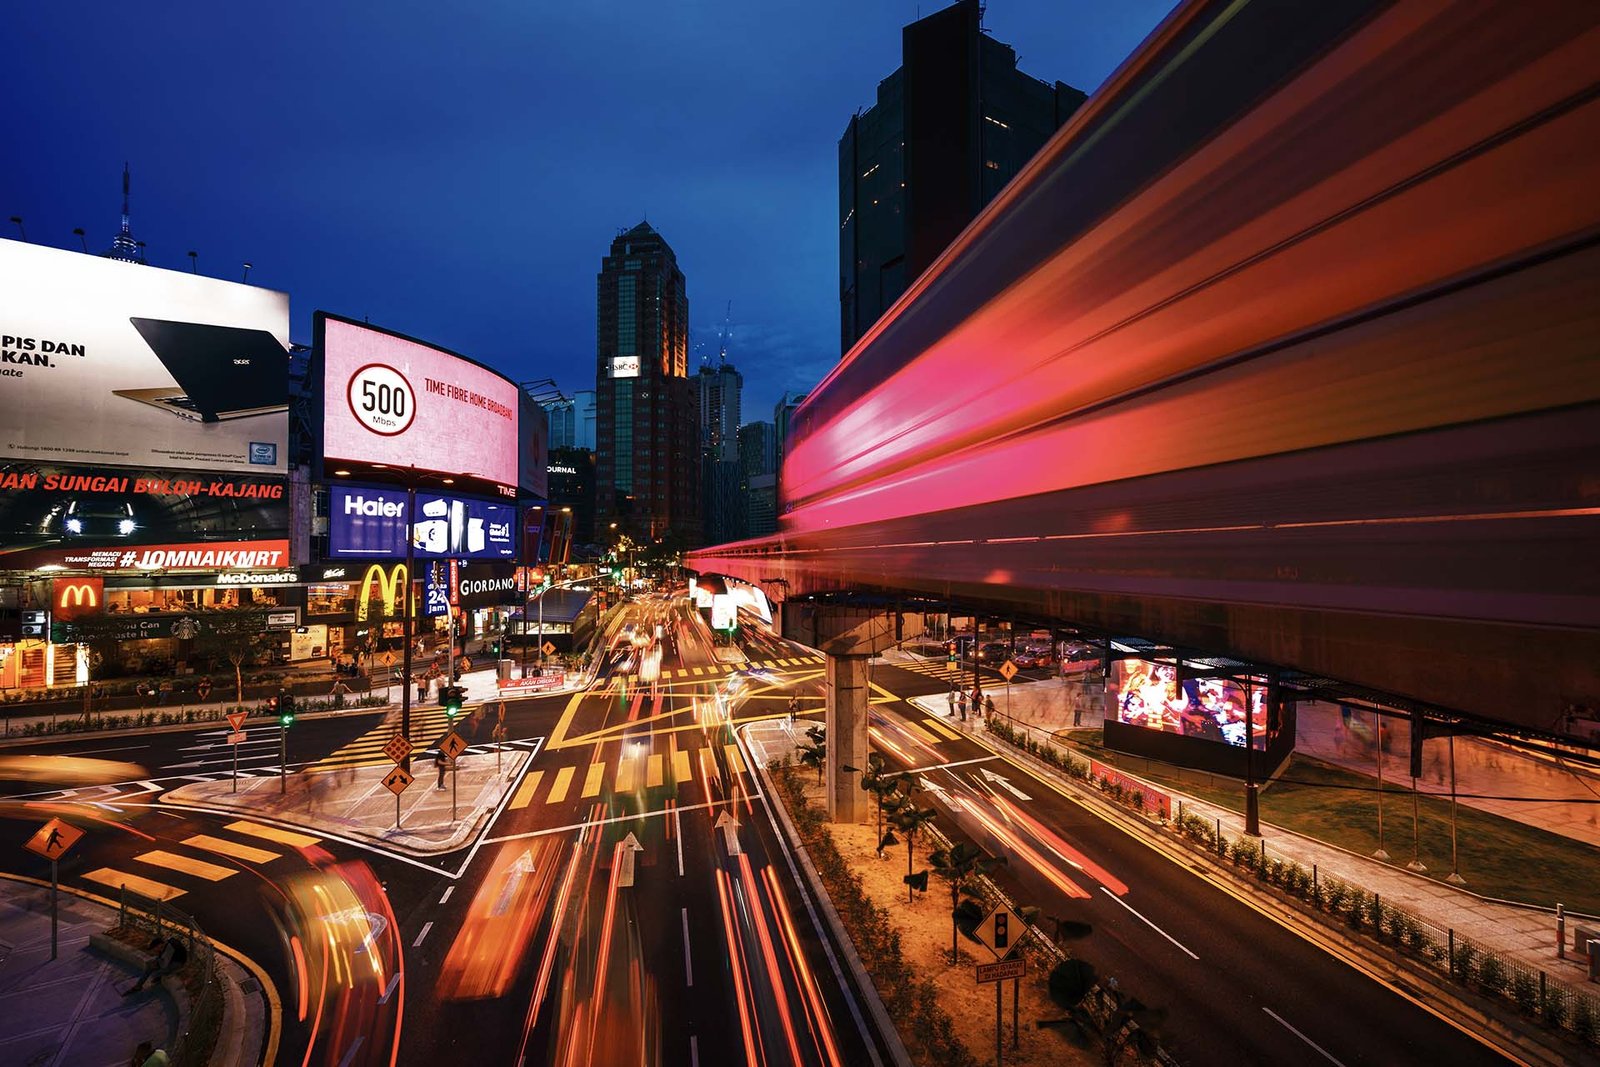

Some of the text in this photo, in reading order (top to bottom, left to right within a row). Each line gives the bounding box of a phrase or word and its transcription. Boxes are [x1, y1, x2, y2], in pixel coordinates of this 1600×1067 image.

[2, 335, 85, 357] PIS DAN
[0, 349, 56, 368] KAN.
[609, 363, 628, 371] HSBC
[362, 379, 405, 417] 500
[424, 377, 513, 421] TIME FIBRE HOME BROADBAND
[372, 415, 397, 426] Mbps
[43, 473, 129, 493] SUNGAI
[133, 478, 284, 499] BULOH-KAJANG
[496, 484, 516, 498] TIME
[344, 495, 404, 517] Haier
[119, 550, 283, 569] #JOMNAIKMRT
[216, 573, 298, 584] McDonald's
[460, 577, 514, 596] GIORDANO
[428, 590, 446, 605] 24
[428, 605, 446, 614] jam
[139, 621, 160, 630] Can
